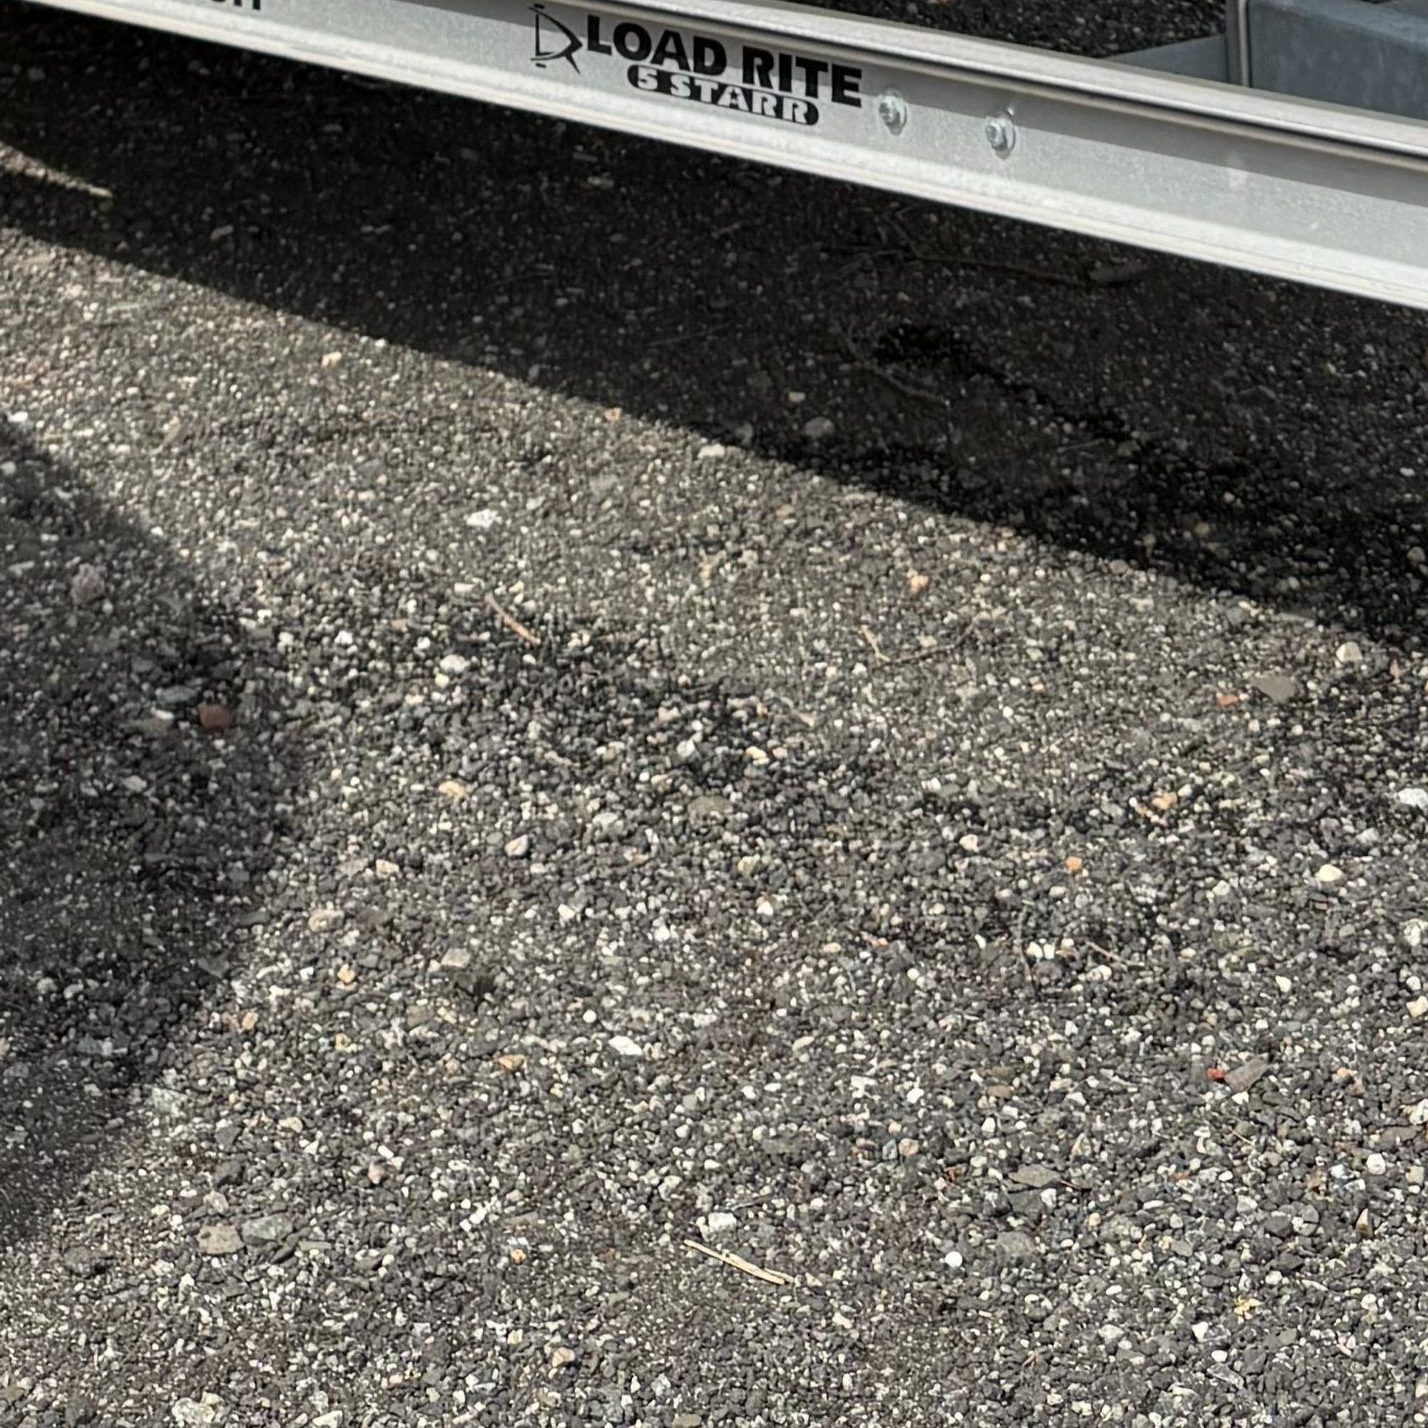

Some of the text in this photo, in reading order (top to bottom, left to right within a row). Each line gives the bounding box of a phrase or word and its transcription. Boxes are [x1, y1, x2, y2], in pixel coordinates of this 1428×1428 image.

[587, 14, 862, 108] LOAD RITE
[636, 68, 809, 125] 5 STARR
